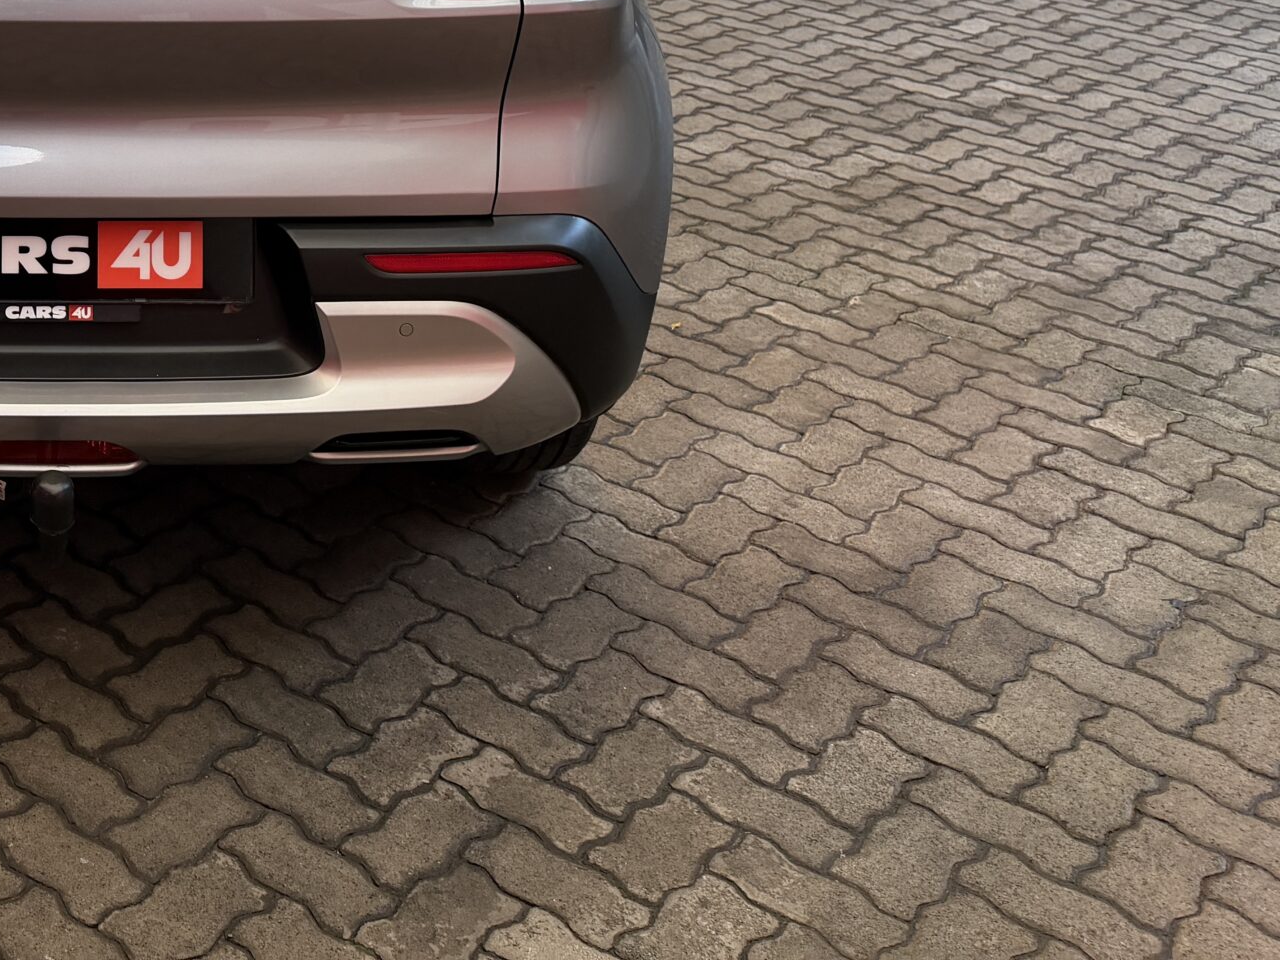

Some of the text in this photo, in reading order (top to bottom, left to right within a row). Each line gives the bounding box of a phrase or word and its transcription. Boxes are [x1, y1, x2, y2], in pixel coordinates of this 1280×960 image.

[110, 229, 192, 280] 4U
[5, 306, 92, 319] CARS 4U
